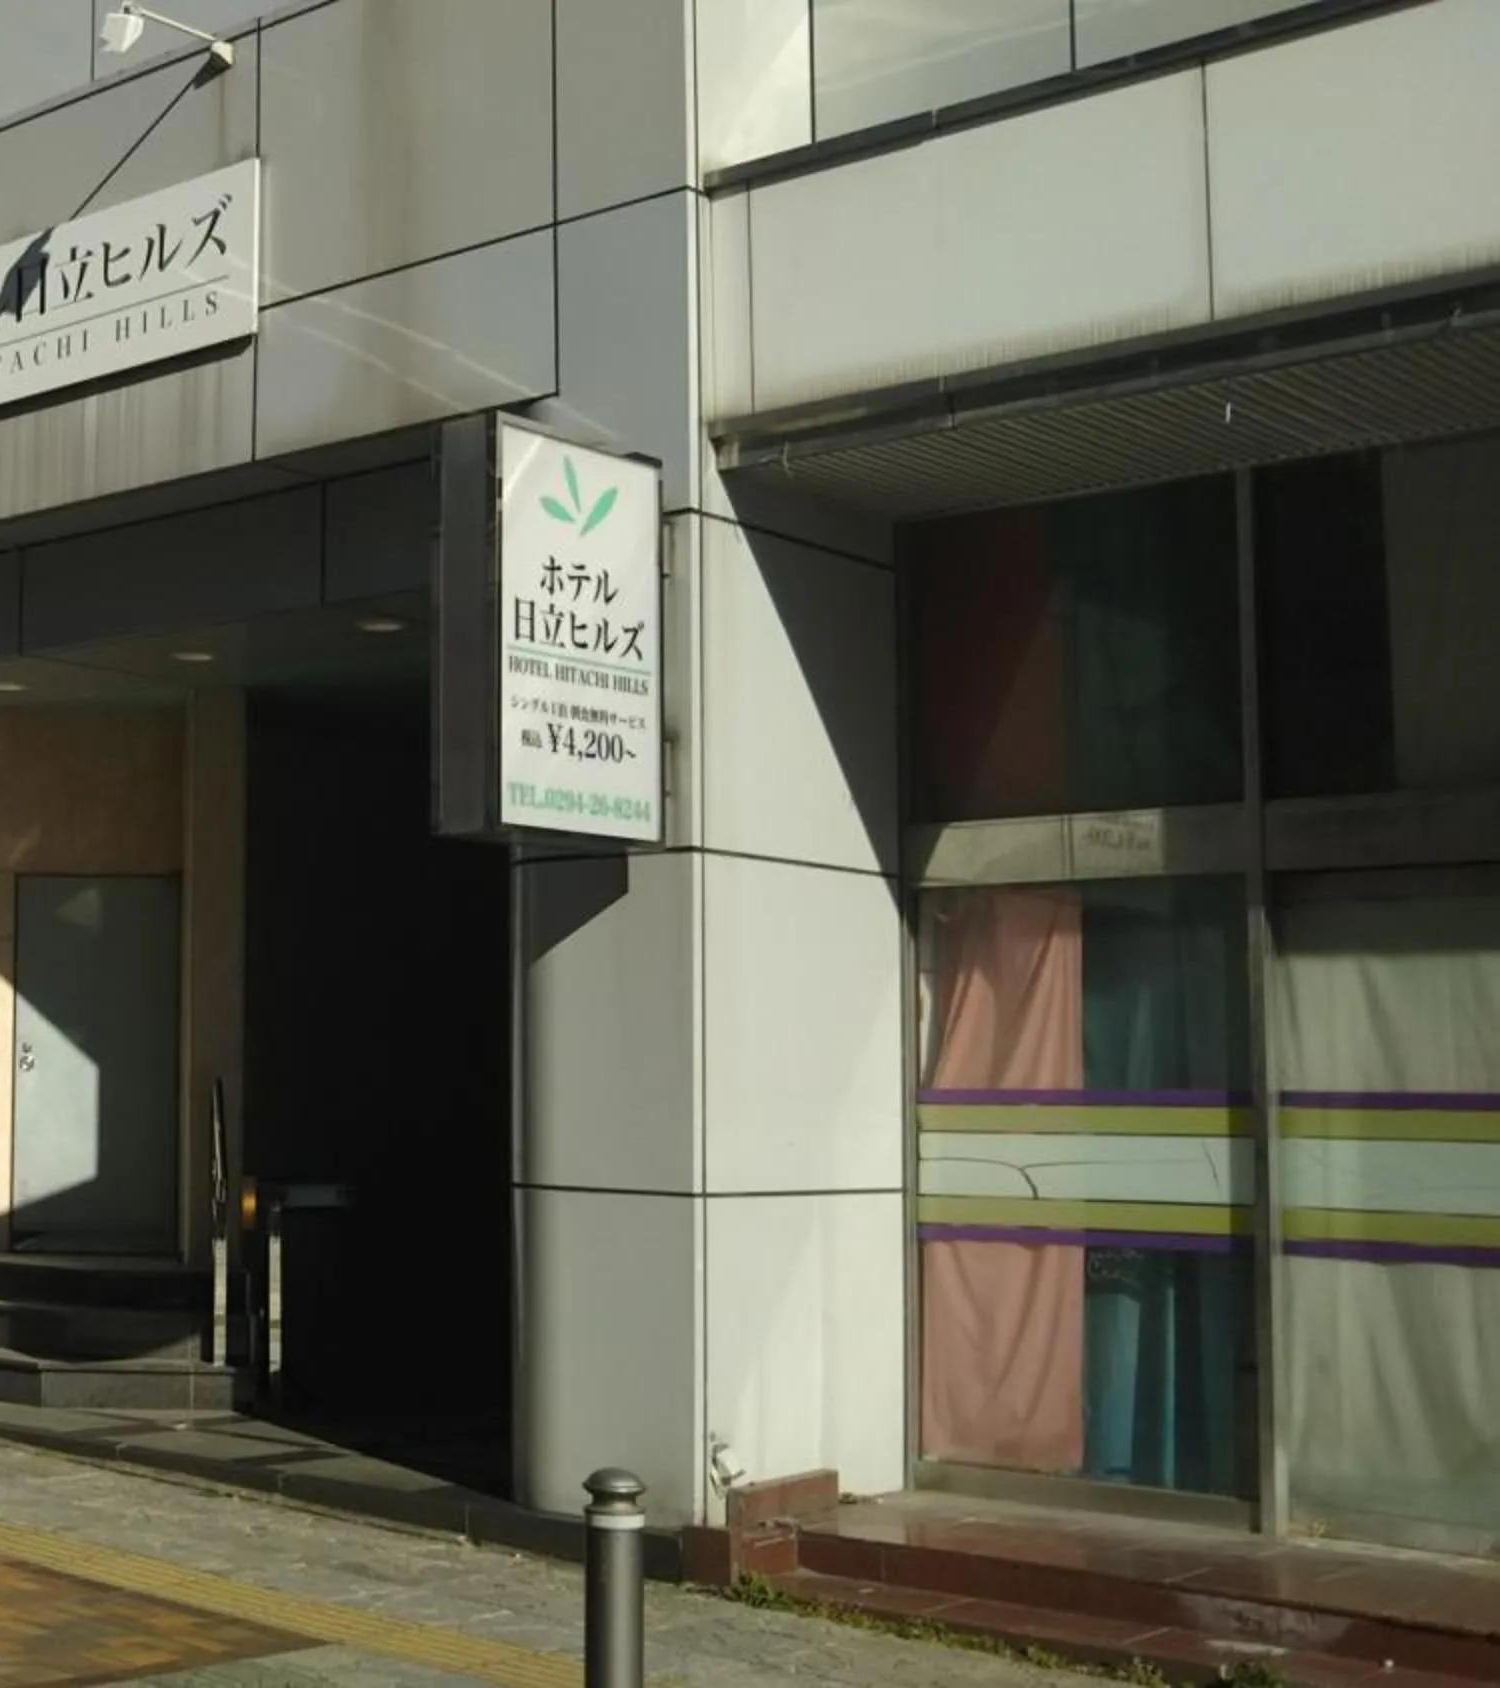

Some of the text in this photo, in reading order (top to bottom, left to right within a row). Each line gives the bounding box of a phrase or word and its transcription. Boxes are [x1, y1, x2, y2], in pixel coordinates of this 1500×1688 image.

[114, 290, 221, 343] HILLS
[540, 554, 619, 605] ホテル
[514, 595, 645, 662] 日立ヒルズ
[509, 655, 650, 697] HOTEL HITACHI HILLS
